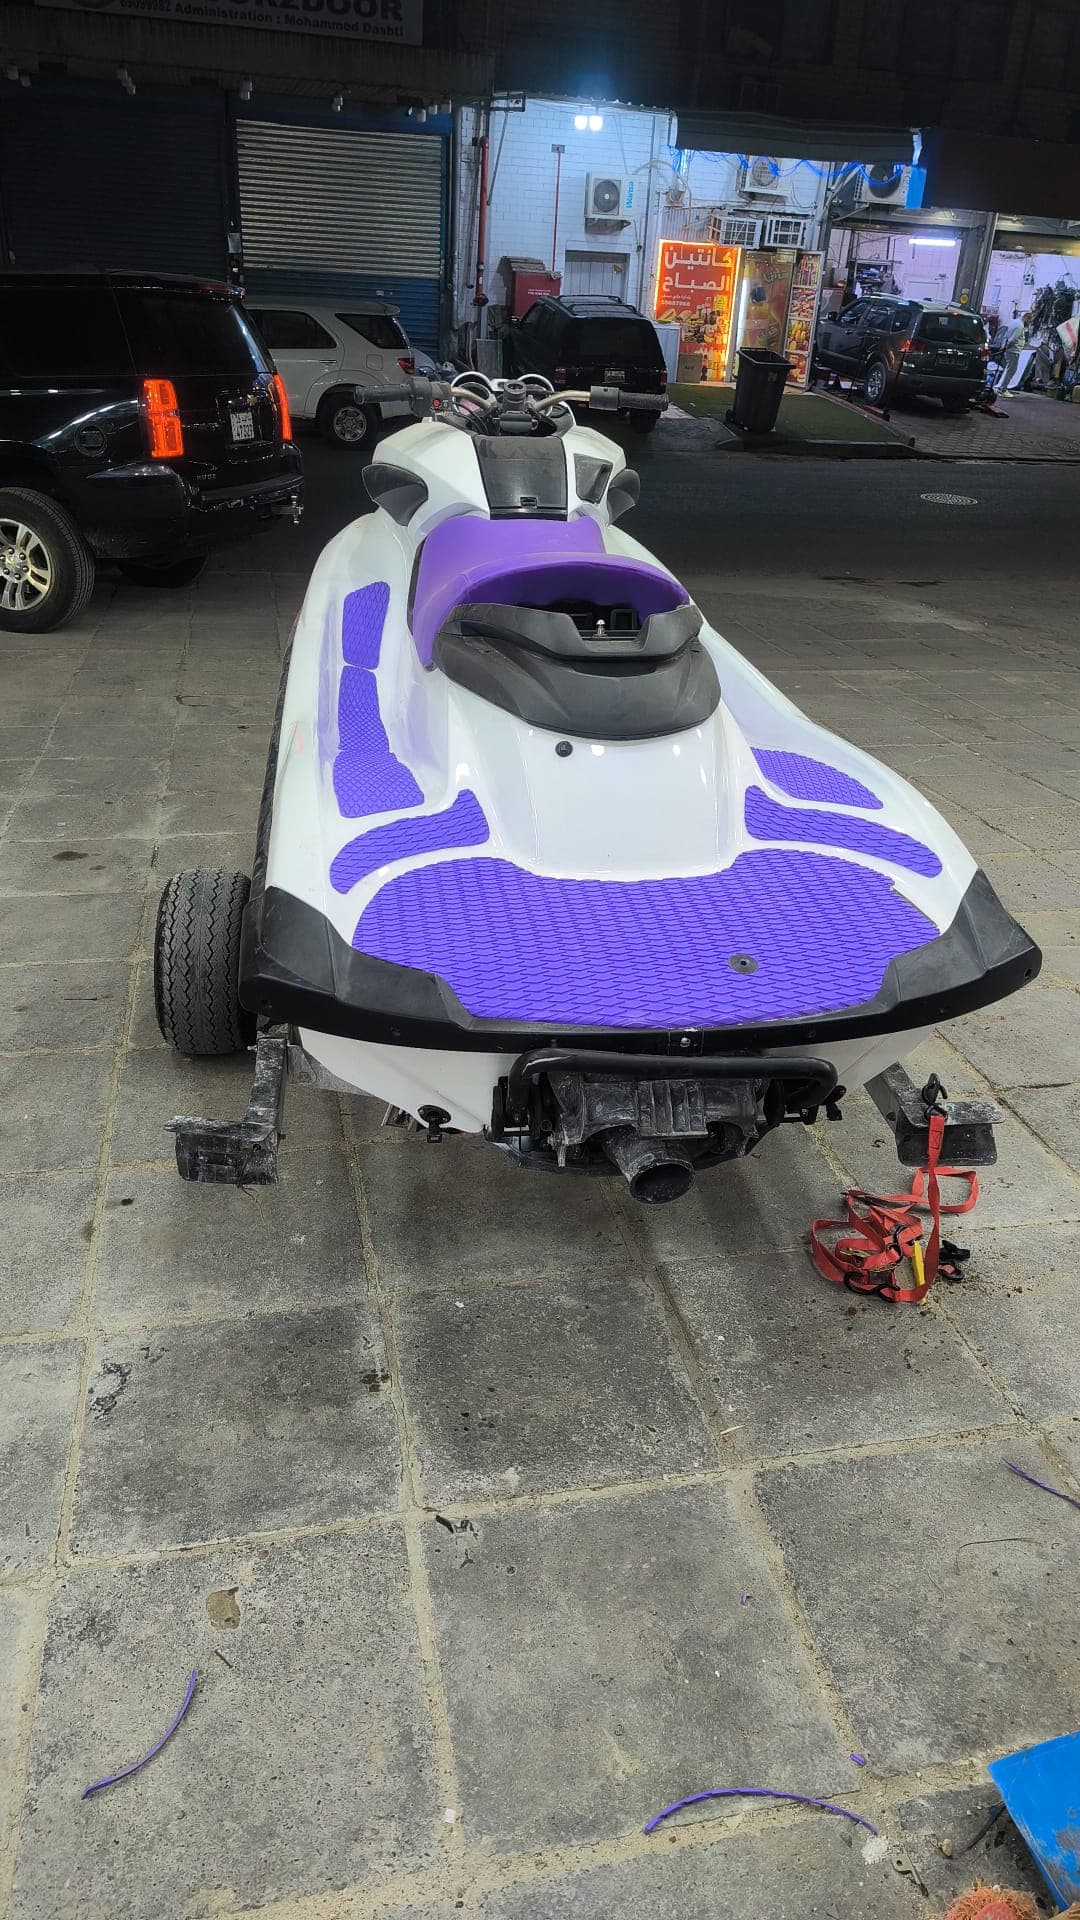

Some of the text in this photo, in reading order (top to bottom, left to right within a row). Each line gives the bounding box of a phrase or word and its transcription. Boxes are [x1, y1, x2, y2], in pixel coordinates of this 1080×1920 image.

[176, 3, 273, 22] Administration
[285, 14, 359, 32] Mohammed
[363, 22, 403, 36] Dashti
[665, 246, 734, 270] كانتين
[662, 271, 731, 293] الصباح
